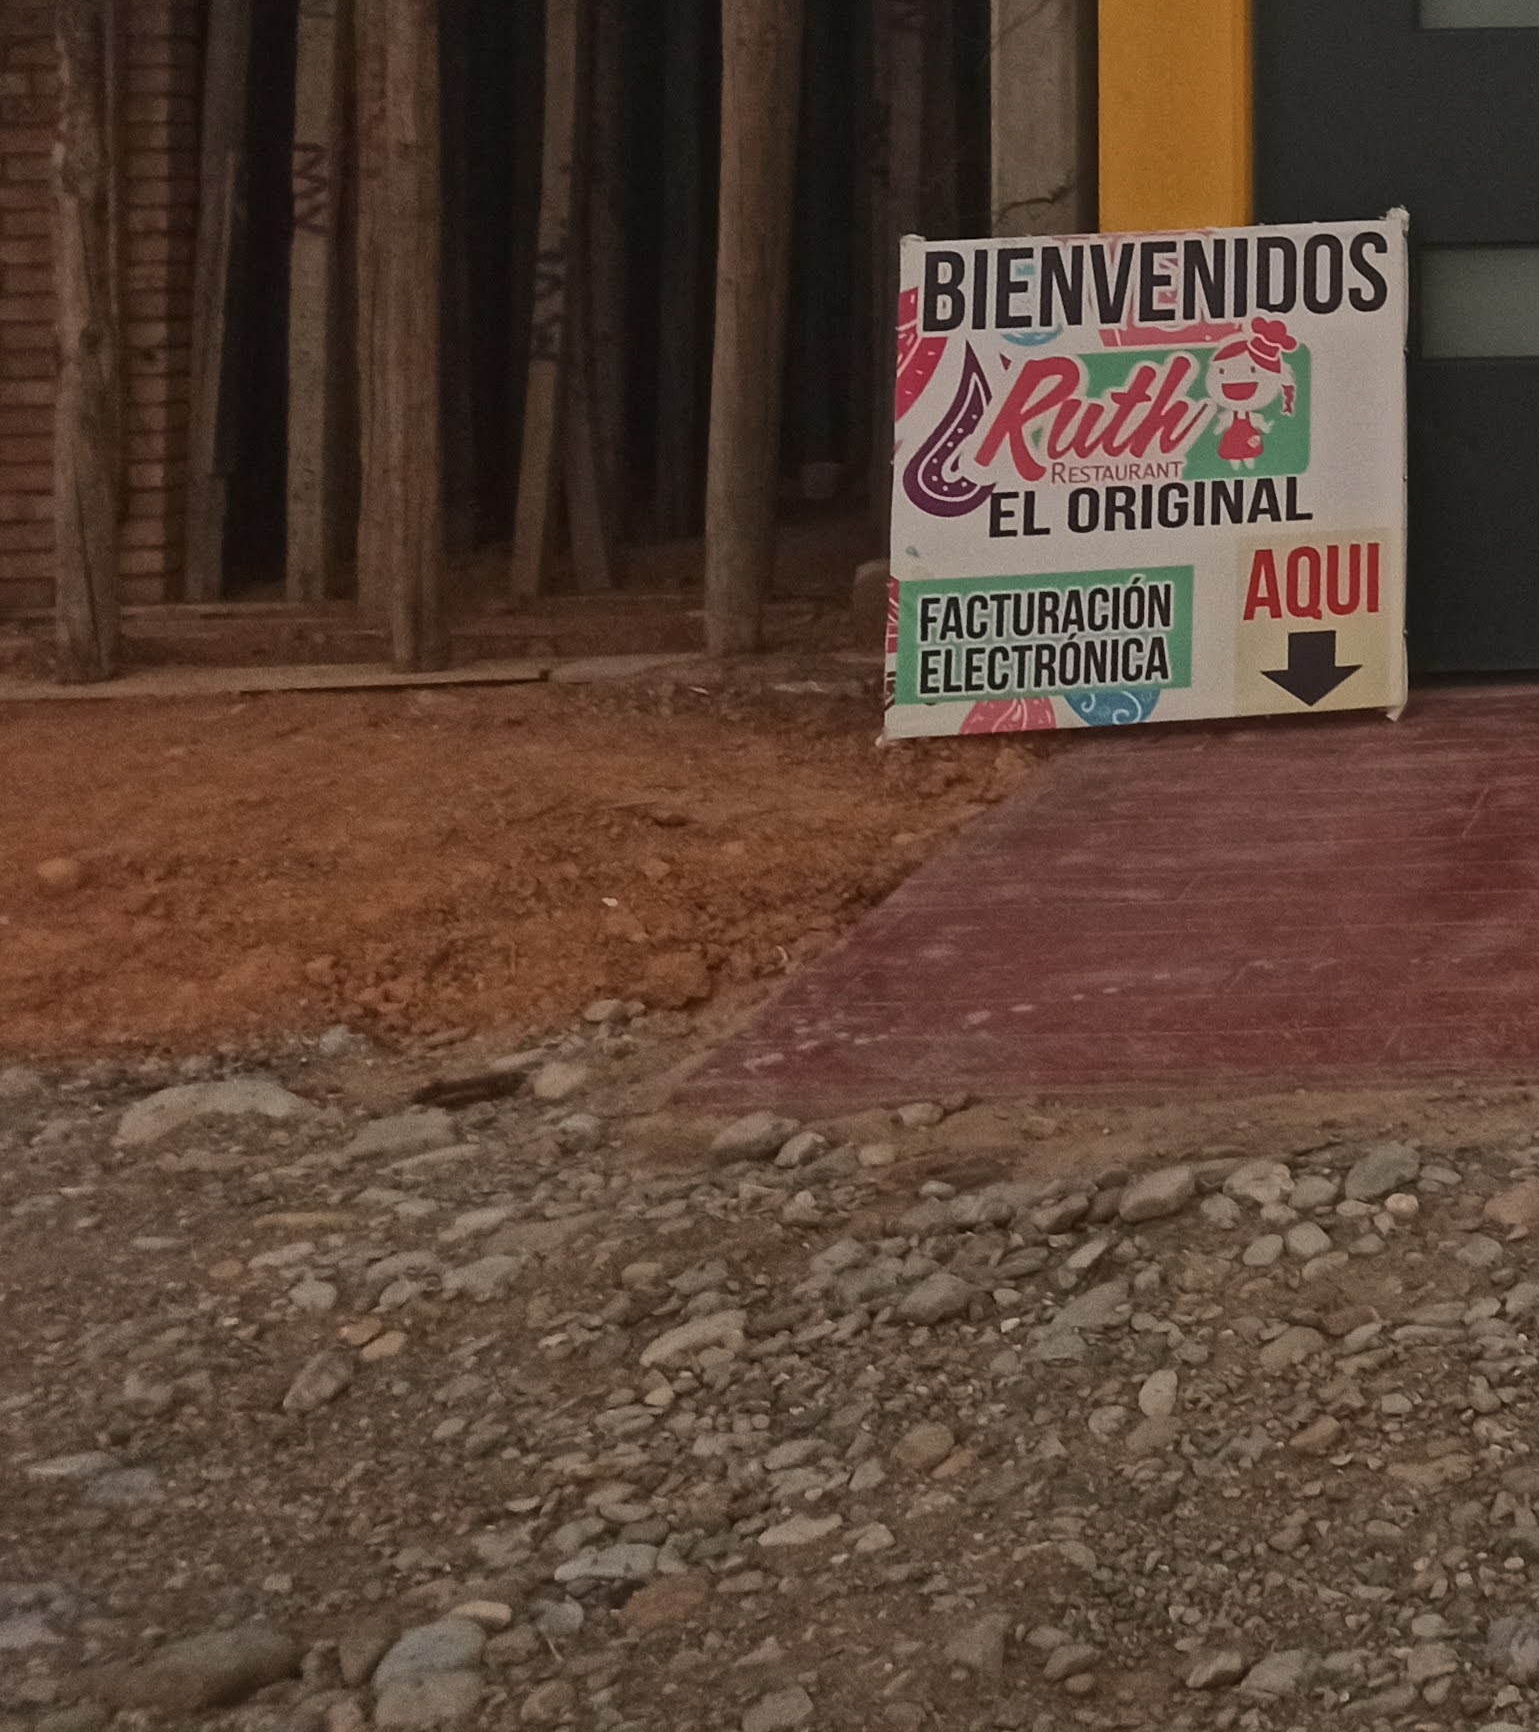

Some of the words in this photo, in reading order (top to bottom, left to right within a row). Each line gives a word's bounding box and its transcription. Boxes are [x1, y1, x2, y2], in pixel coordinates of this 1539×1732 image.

[921, 231, 1388, 332] BIENVENIDOS
[973, 355, 1208, 483] Ruth
[988, 491, 1051, 538] EL
[1067, 476, 1313, 532] ORIGINAL
[919, 577, 1173, 642] FACTURACIÓN
[1242, 542, 1380, 621] AQUI
[918, 633, 1170, 696] ELECTRÓNICA
